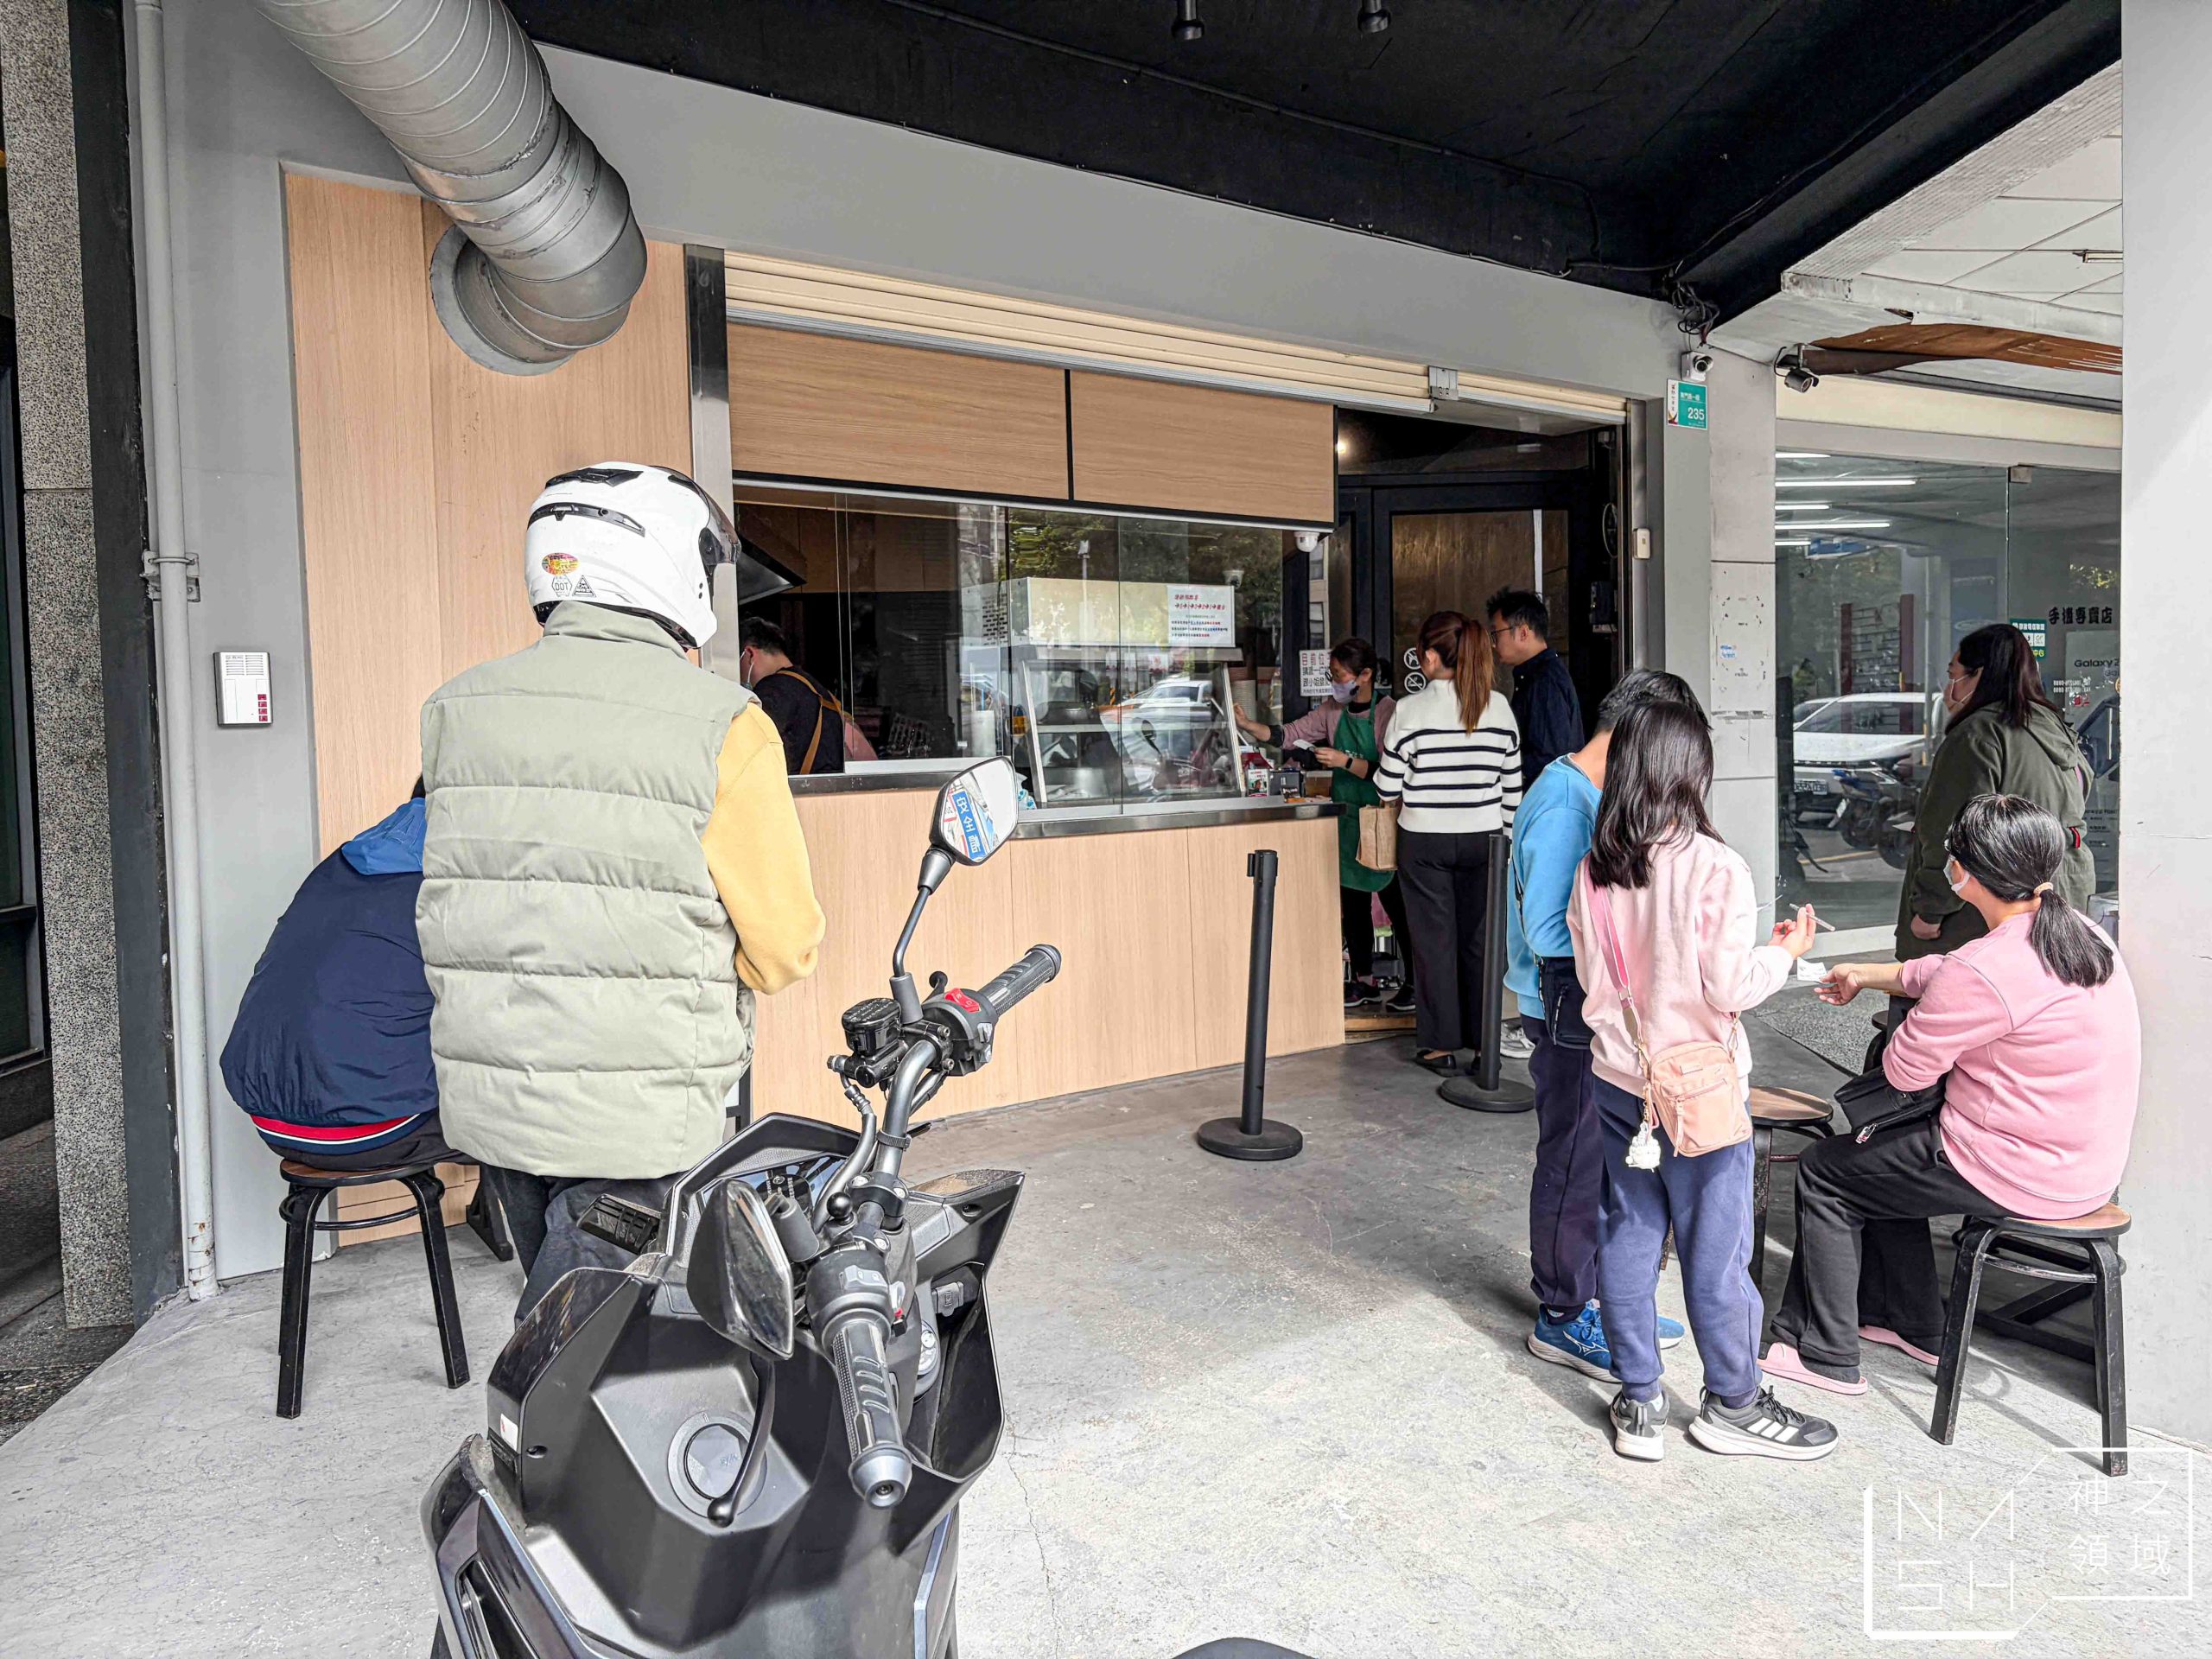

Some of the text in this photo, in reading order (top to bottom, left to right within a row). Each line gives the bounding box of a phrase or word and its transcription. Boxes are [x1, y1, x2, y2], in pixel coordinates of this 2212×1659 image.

[1688, 407, 1705, 421] 235
[555, 582, 569, 591] DOT
[2048, 607, 2113, 625] 手機專賣店
[2074, 658, 2113, 668] Galaxy
